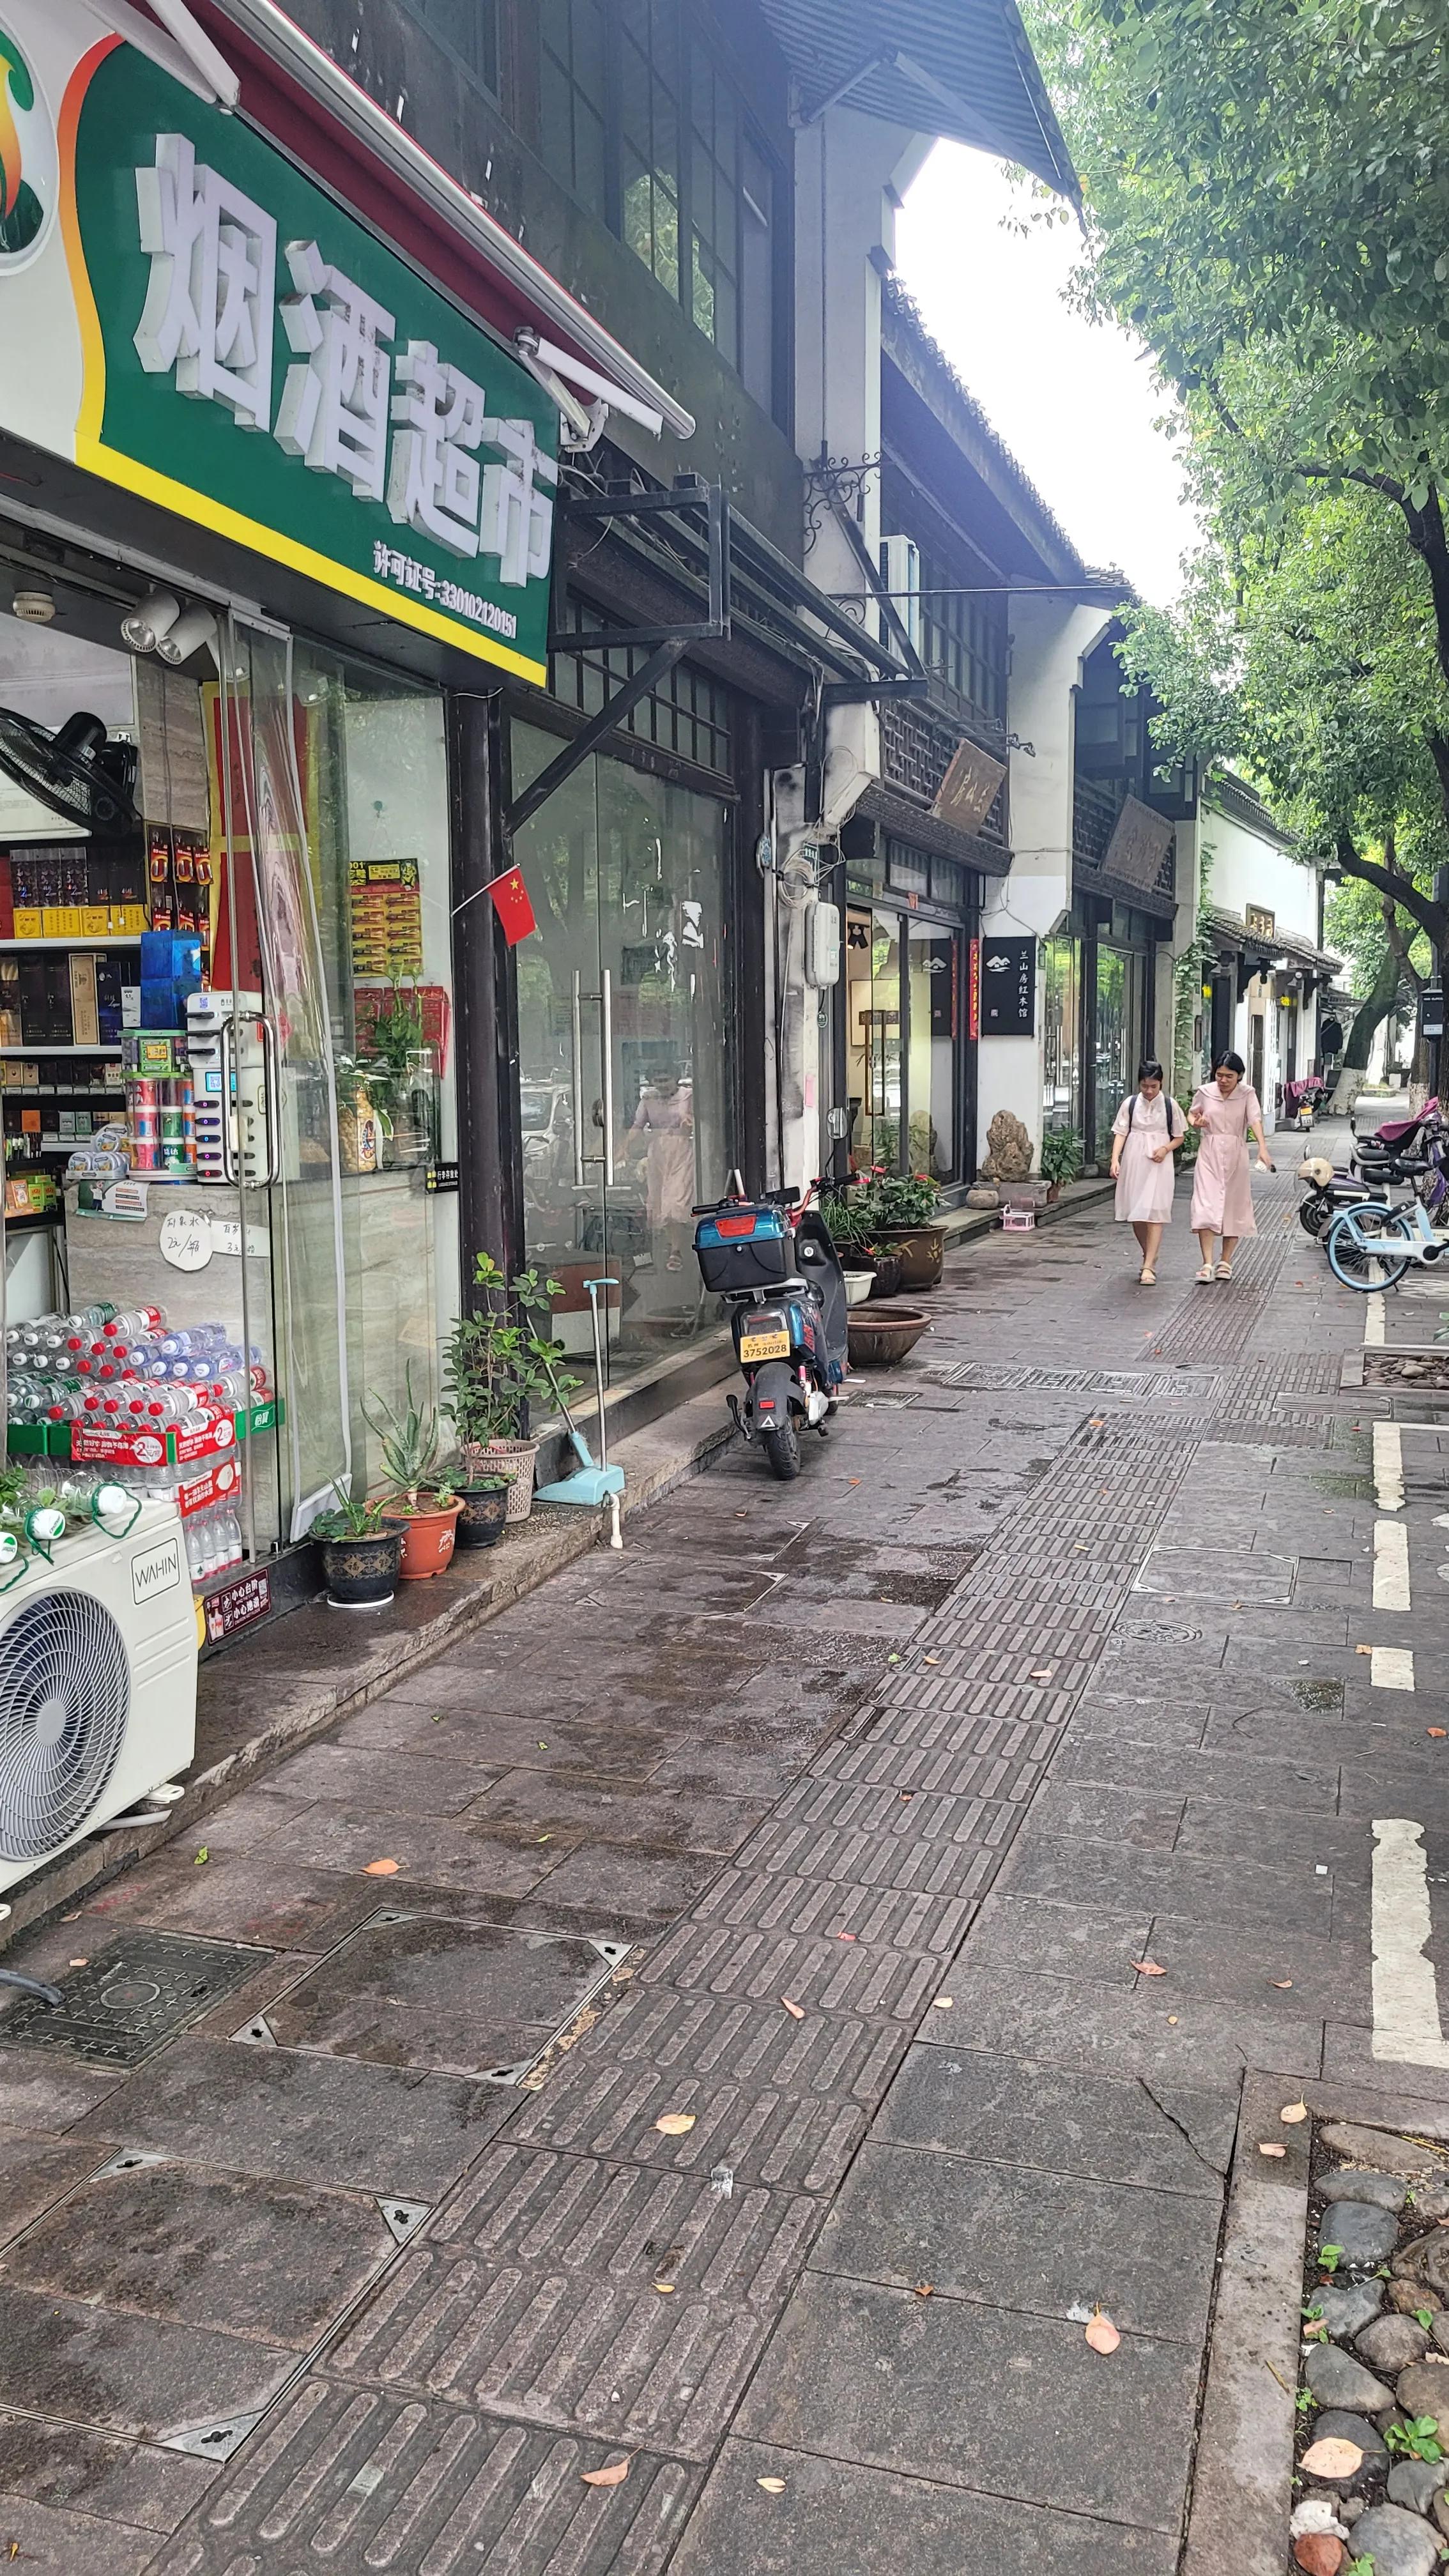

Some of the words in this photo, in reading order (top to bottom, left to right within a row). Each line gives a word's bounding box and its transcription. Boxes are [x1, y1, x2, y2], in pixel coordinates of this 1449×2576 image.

[134, 134, 558, 588] 烟酒超市
[744, 1344, 787, 1358] 3752028
[135, 1552, 176, 1588] WAHIN
[232, 1579, 258, 1601] 小心台阶
[233, 1596, 260, 1619] 小心地滑
